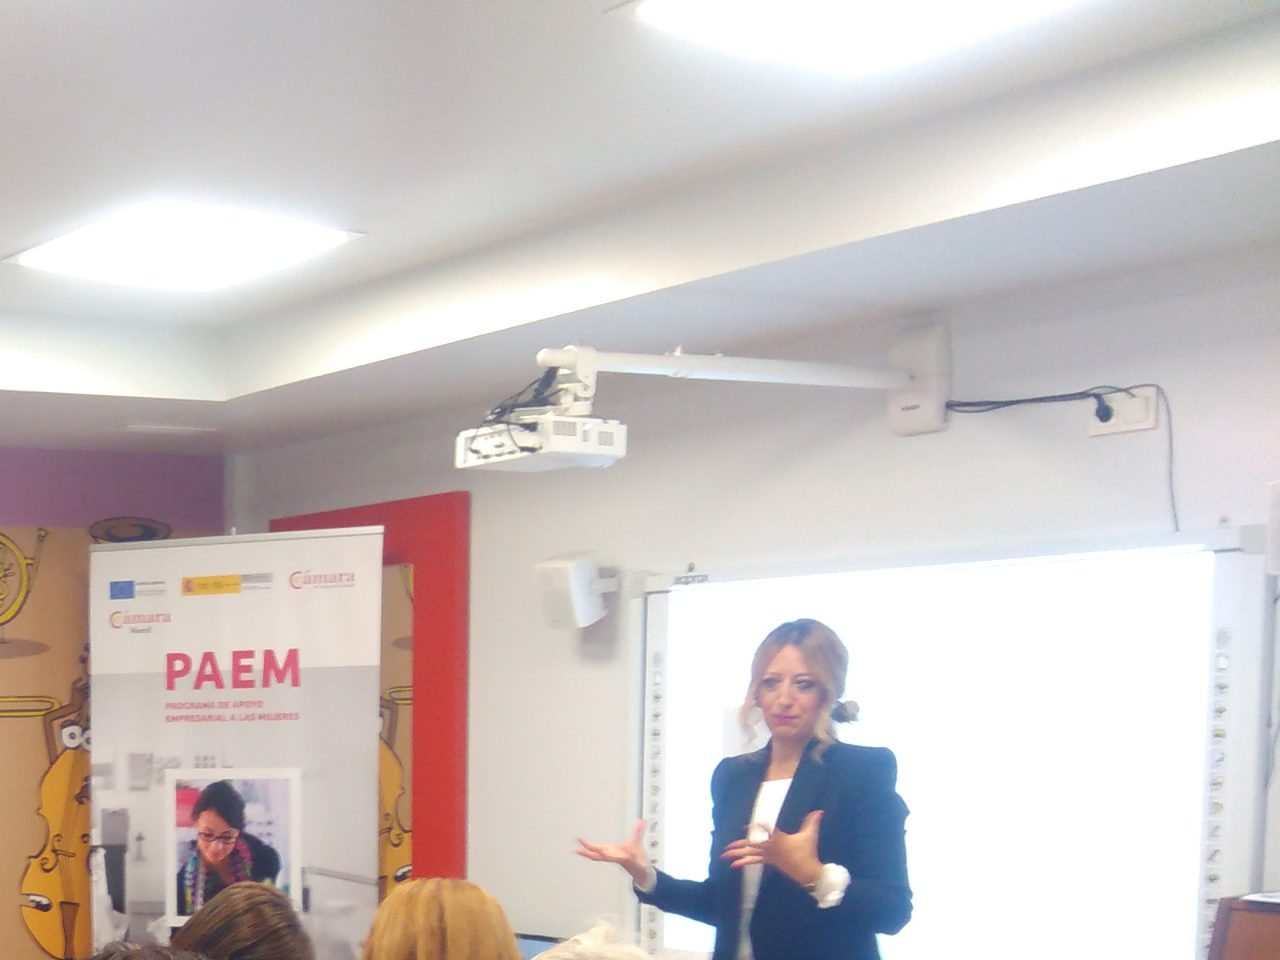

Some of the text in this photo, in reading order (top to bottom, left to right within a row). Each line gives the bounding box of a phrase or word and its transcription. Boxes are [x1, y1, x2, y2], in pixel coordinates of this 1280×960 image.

[166, 648, 300, 691] PAEM
[165, 699, 264, 710] PROGRAMA DE APOYO
